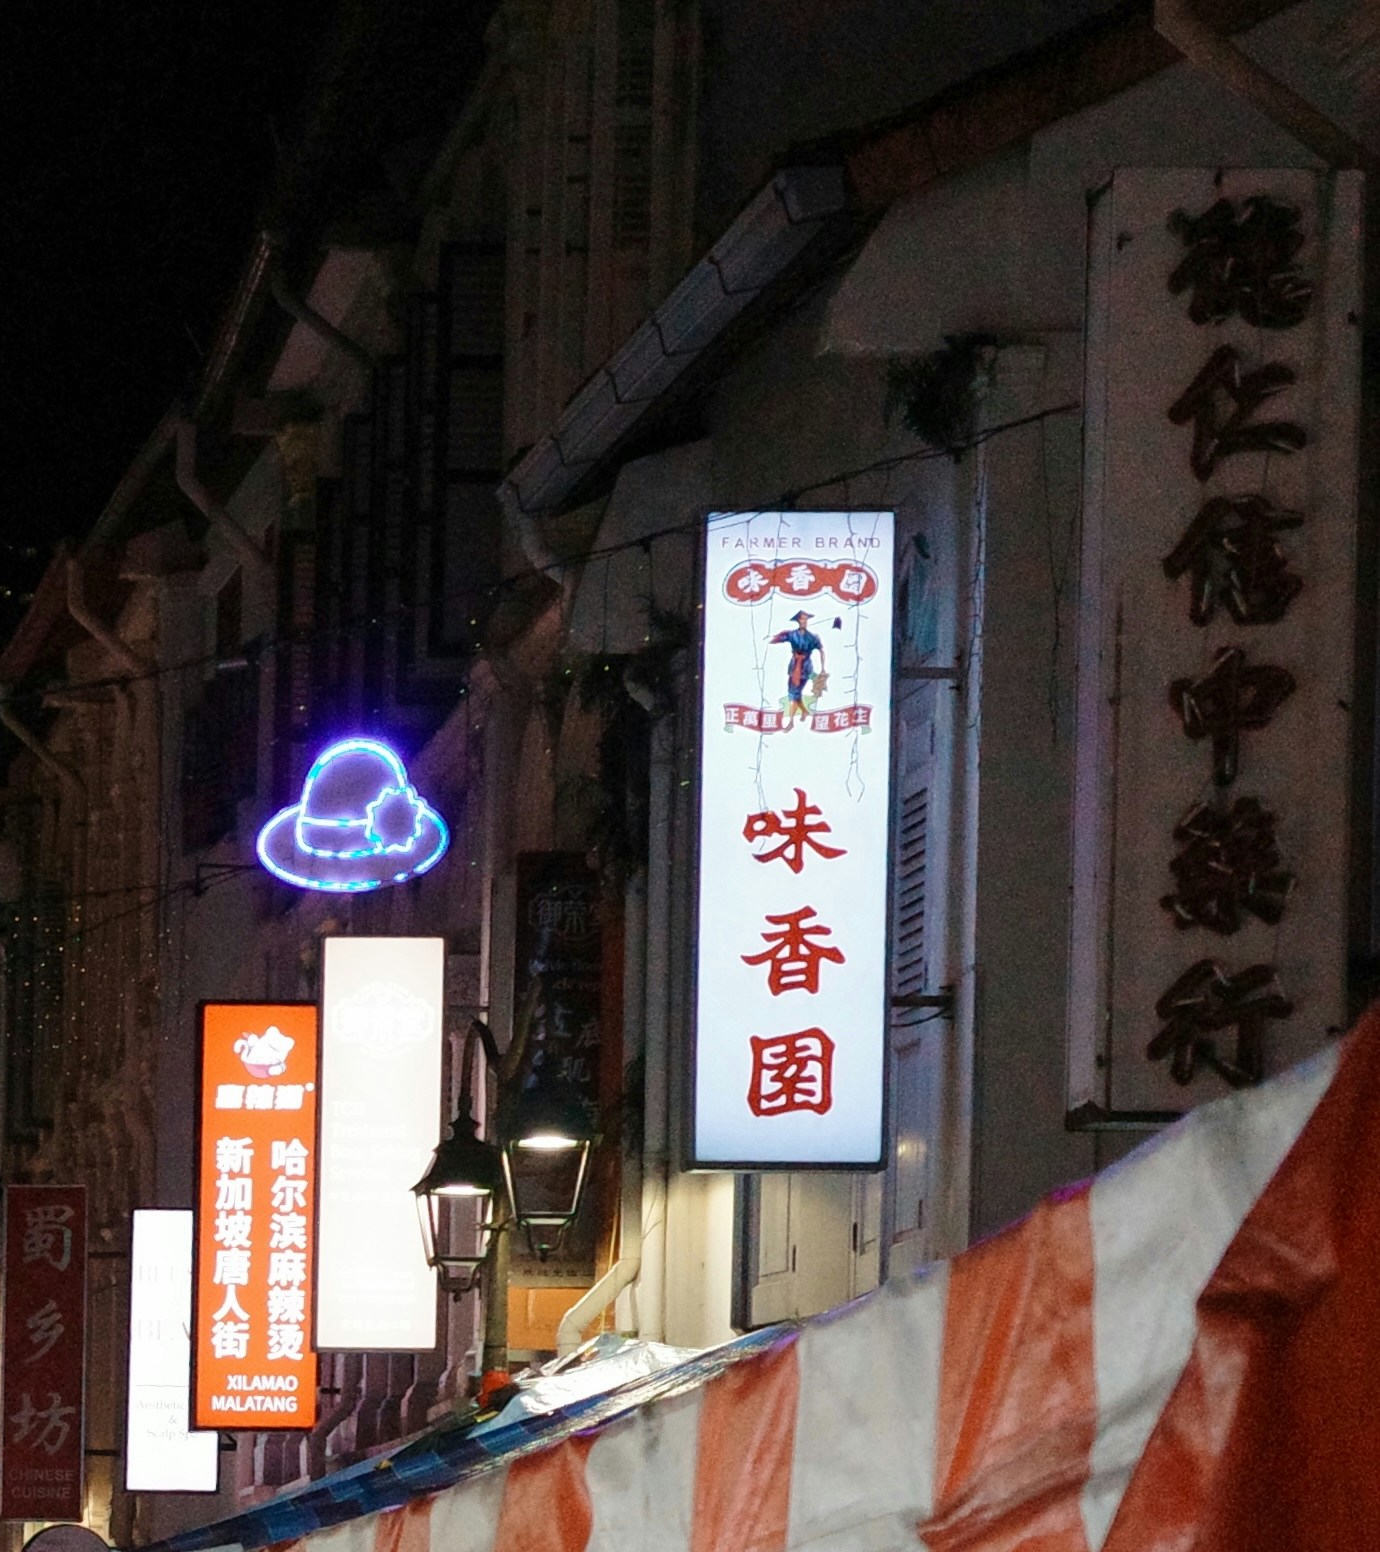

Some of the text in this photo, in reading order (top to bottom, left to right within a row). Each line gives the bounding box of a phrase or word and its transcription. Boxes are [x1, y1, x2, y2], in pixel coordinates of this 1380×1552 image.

[721, 537, 881, 549] FARMER BRAND
[211, 1136, 255, 1360] 新加坡唐人街
[266, 1138, 309, 1361] 哈尔滨麻辣烫
[9, 1205, 76, 1458] 蜀乡坊
[226, 1375, 298, 1391] XILAMAO
[211, 1396, 298, 1412] MALATANG
[8, 1468, 75, 1483] CHINESE
[11, 1485, 72, 1500] CUISINE
